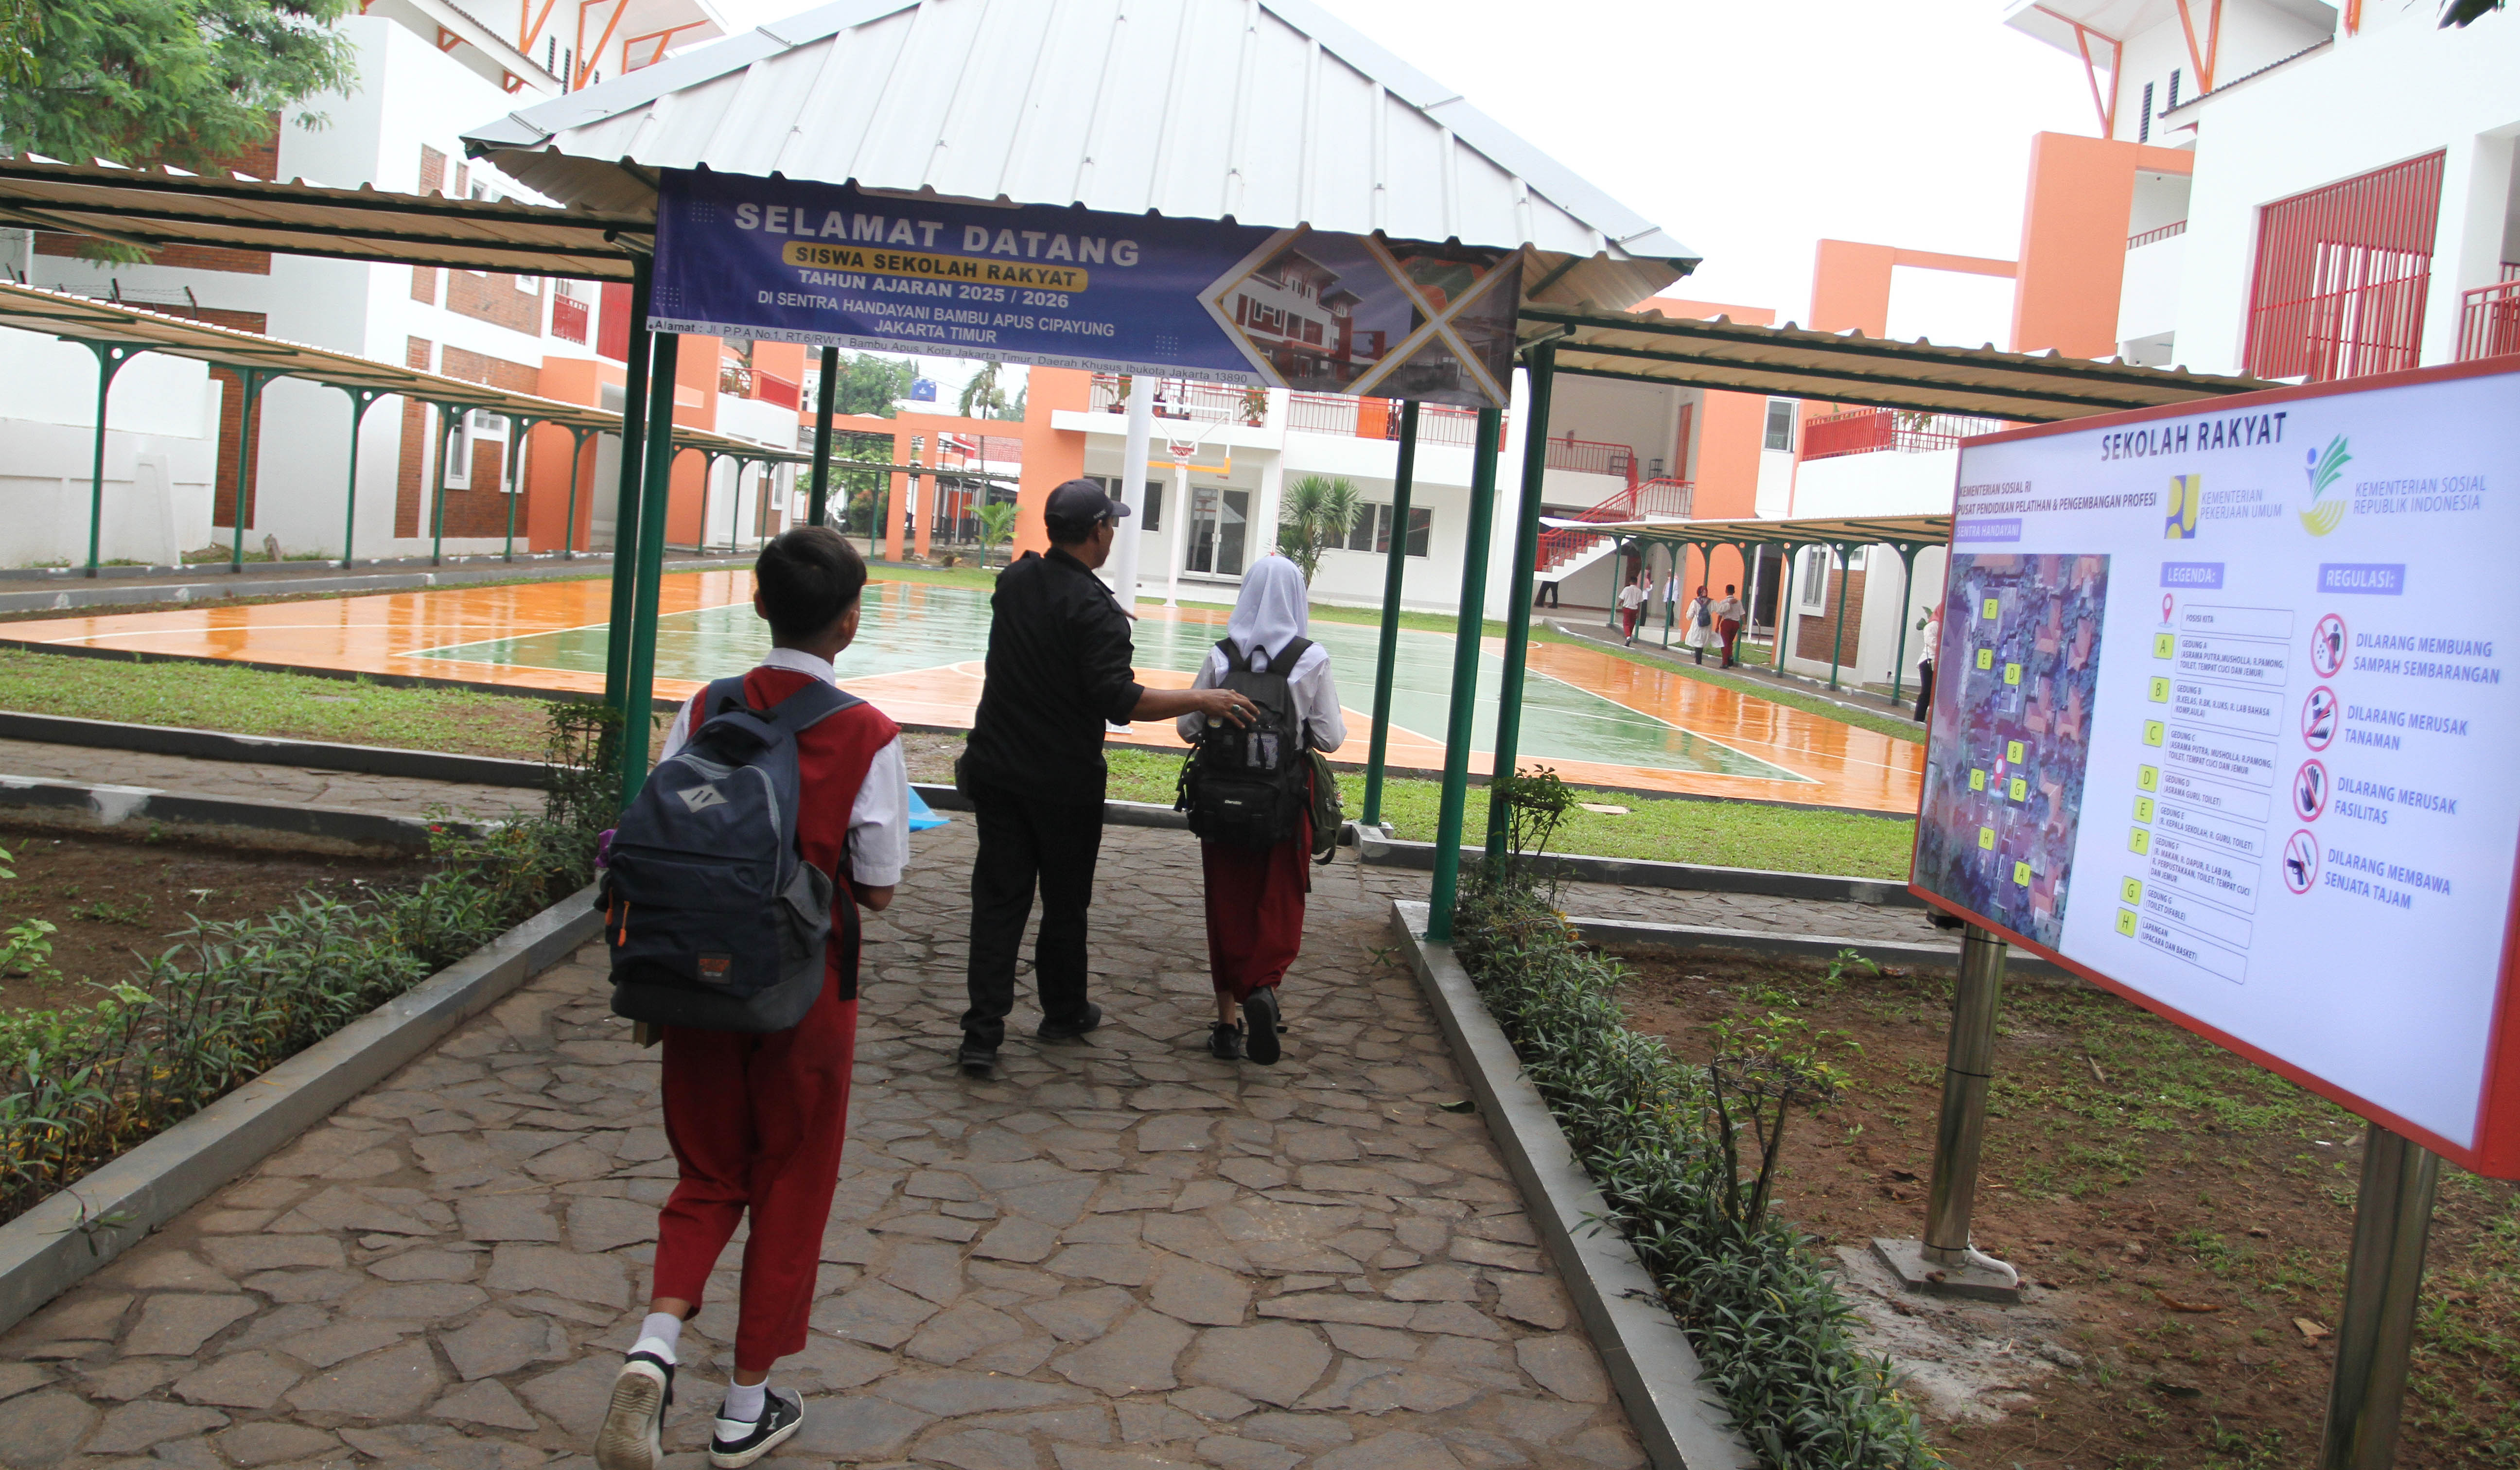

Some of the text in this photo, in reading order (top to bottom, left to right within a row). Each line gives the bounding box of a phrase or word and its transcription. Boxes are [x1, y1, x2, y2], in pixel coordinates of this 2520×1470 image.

[735, 203, 1139, 266] SELAMAT DATANG
[795, 247, 1076, 286] SISWA SEKOLAH RAKYAT
[798, 269, 1068, 308] TAHUN AJARAN 2025 / 2026
[758, 291, 1115, 337] DI SENTRA HANDAYANI BAMBU APUS CIPAYUNG
[875, 319, 997, 343] JAKARTA TIMUR
[655, 320, 695, 332] Alamat
[706, 325, 719, 334] Jl.
[723, 327, 751, 337] P.P.A
[850, 338, 886, 350] Bambu
[891, 342, 922, 354] Apus,
[927, 346, 951, 355] Kota
[955, 348, 996, 360] Jakarta
[1000, 352, 1033, 365] Timur,
[1038, 356, 1077, 367] Daerah
[1082, 360, 1121, 372] Khusus
[1126, 365, 1165, 376] Ibukota
[1169, 368, 1209, 380] Jakarta
[1215, 372, 1247, 384] 13890
[2101, 412, 2286, 461] SEKOLAH RAKYAT
[1959, 481, 2031, 497] KEMENTERIAN SOSIAL RI
[2355, 474, 2485, 497] KEMENTERIAN SOSIAL
[1957, 492, 2156, 515] PUSAT PENDIDIKAN PELATIHAN & PENGEMBANGAN PROFESI
[2202, 489, 2262, 504] KEMENTERIAN
[2201, 504, 2282, 519] PEKERJAAN UMUM
[2353, 495, 2480, 514] REPUBLIK INDONESIA
[1957, 525, 2019, 537] SENTRA HANDAYANI
[2168, 568, 2216, 583] LEGENDA:
[2326, 570, 2394, 588] REGULASI:
[1988, 603, 1992, 614] F
[2186, 614, 2202, 623] POSISI
[2159, 639, 2166, 653] A
[2182, 640, 2203, 649] GEDUNG
[2357, 633, 2492, 657] DILARANG MEMBUANG
[1982, 653, 1986, 665] E
[2010, 667, 2014, 680] D
[2198, 663, 2217, 672] TEMPAT
[2218, 665, 2230, 673] CUCI
[2353, 656, 2500, 683] SAMPAH SEMBARANGAN
[2156, 682, 2161, 697] B
[2177, 684, 2197, 694] GEDUNG
[2236, 704, 2247, 712] LAB
[2247, 706, 2270, 716] BAHASA
[2347, 705, 2468, 736] DILARANG MERUSAK
[2150, 726, 2156, 740] C
[2171, 730, 2191, 741] GEDUNG
[2345, 728, 2400, 751] TANAMAN
[2012, 747, 2016, 758] B
[2186, 754, 2205, 765] TEMPAT
[2206, 758, 2218, 768] CUCI
[2219, 761, 2229, 770] DAN
[2231, 763, 2248, 774] JEMUR
[1975, 773, 1979, 785] C
[2144, 771, 2150, 785] D
[2165, 774, 2185, 786] GEDUNG
[2015, 784, 2020, 795] G
[2338, 777, 2457, 815] DILARANG MERUSAK
[2140, 802, 2146, 816] E
[2160, 806, 2180, 818] GEDUNG
[2334, 800, 2388, 824] FASILITAS
[2166, 819, 2184, 831] KEPALA
[2185, 824, 2208, 837] SEKOLAH,
[1984, 832, 1989, 844] H
[2136, 833, 2141, 847] F
[2155, 837, 2175, 849] GEDUNG
[2019, 868, 2023, 880] A
[2151, 868, 2177, 883] DAN JEMUR
[2211, 865, 2222, 875] LAB
[2328, 849, 2450, 895] DILARANG MEMBAWA
[2127, 884, 2134, 897] G
[2216, 877, 2236, 891] TEMPAT
[2237, 885, 2250, 896] CUCI
[2325, 871, 2411, 910] SENJATA TAJAM
[2148, 889, 2167, 903] GEDUNG
[2122, 914, 2129, 929] H
[2142, 921, 2168, 937] LAPANGAN
[2165, 941, 2175, 951] DAN
